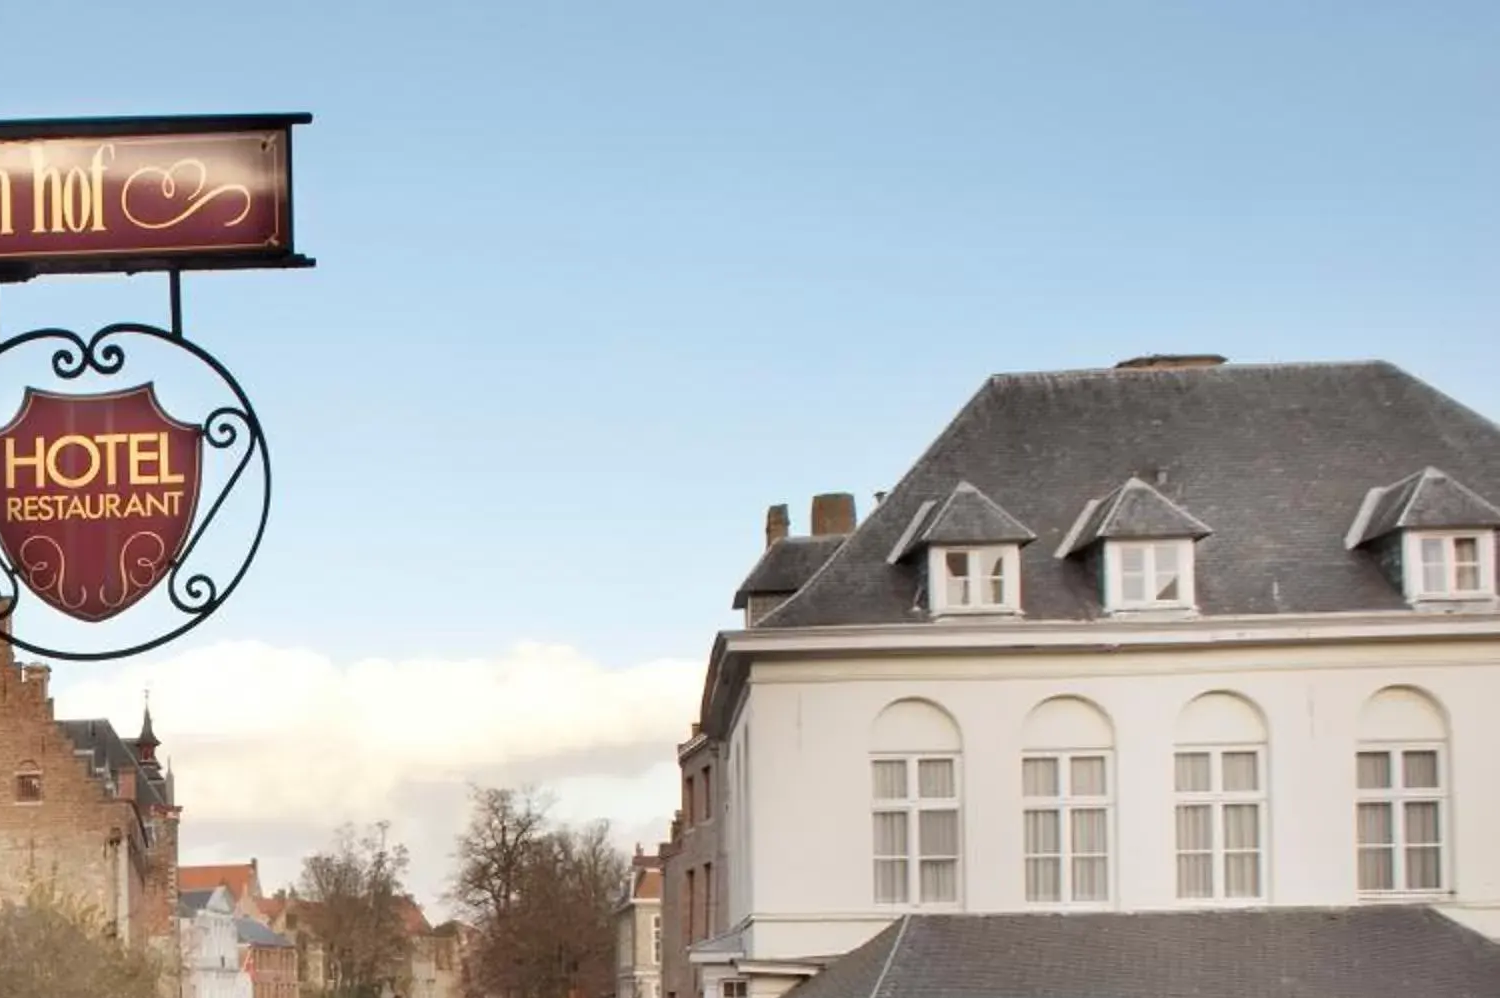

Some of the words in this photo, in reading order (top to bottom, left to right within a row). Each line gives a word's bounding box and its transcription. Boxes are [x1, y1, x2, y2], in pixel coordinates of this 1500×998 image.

[31, 142, 116, 234] hof
[4, 431, 185, 489] HOTEL
[6, 490, 185, 522] RESTAURANT
